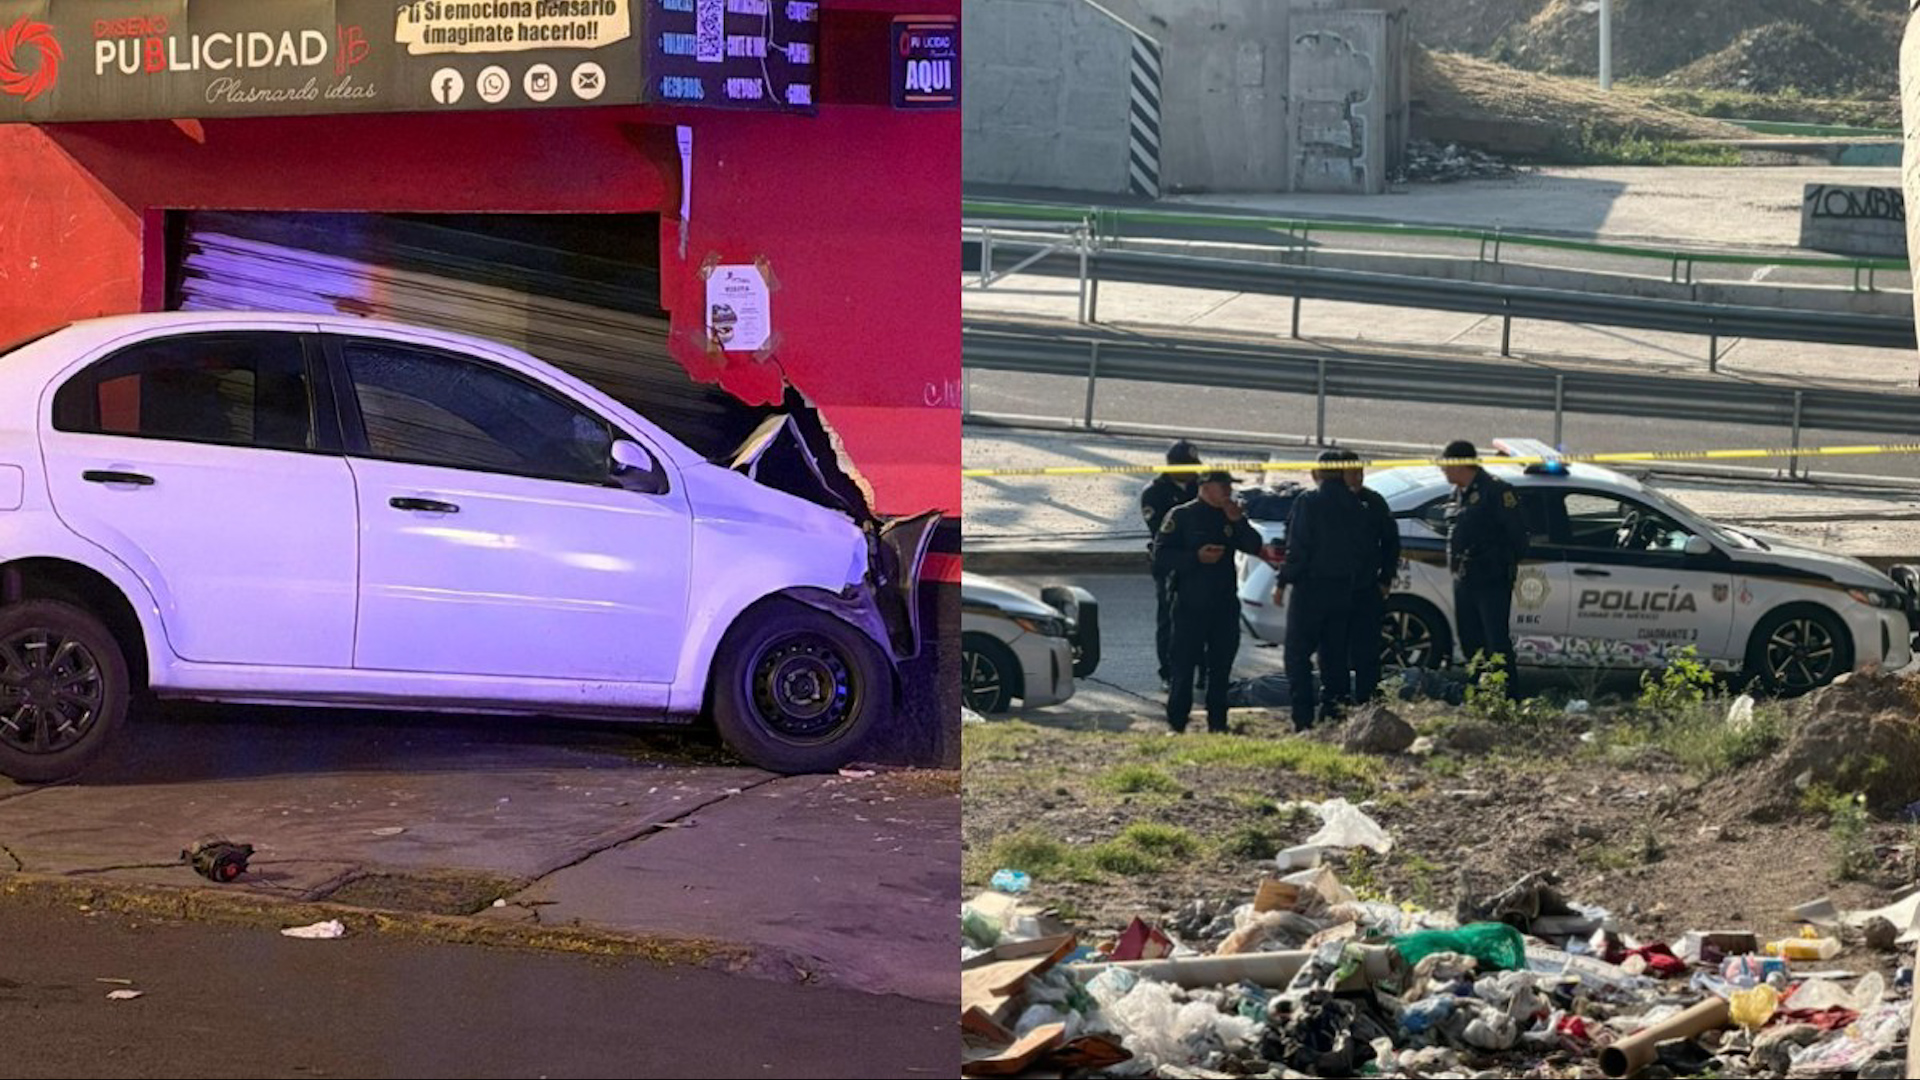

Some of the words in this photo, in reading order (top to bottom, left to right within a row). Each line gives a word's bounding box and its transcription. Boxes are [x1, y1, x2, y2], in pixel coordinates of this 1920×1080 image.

[424, 0, 441, 20] Si
[423, 23, 514, 46] imaginate
[518, 20, 598, 42] hacerlo!!
[95, 30, 328, 75] PUBLICIDAD
[205, 76, 320, 104] Plasmando
[323, 75, 377, 99] ideas
[904, 59, 952, 94] AQUI
[1577, 584, 1698, 613] POLICÍA
